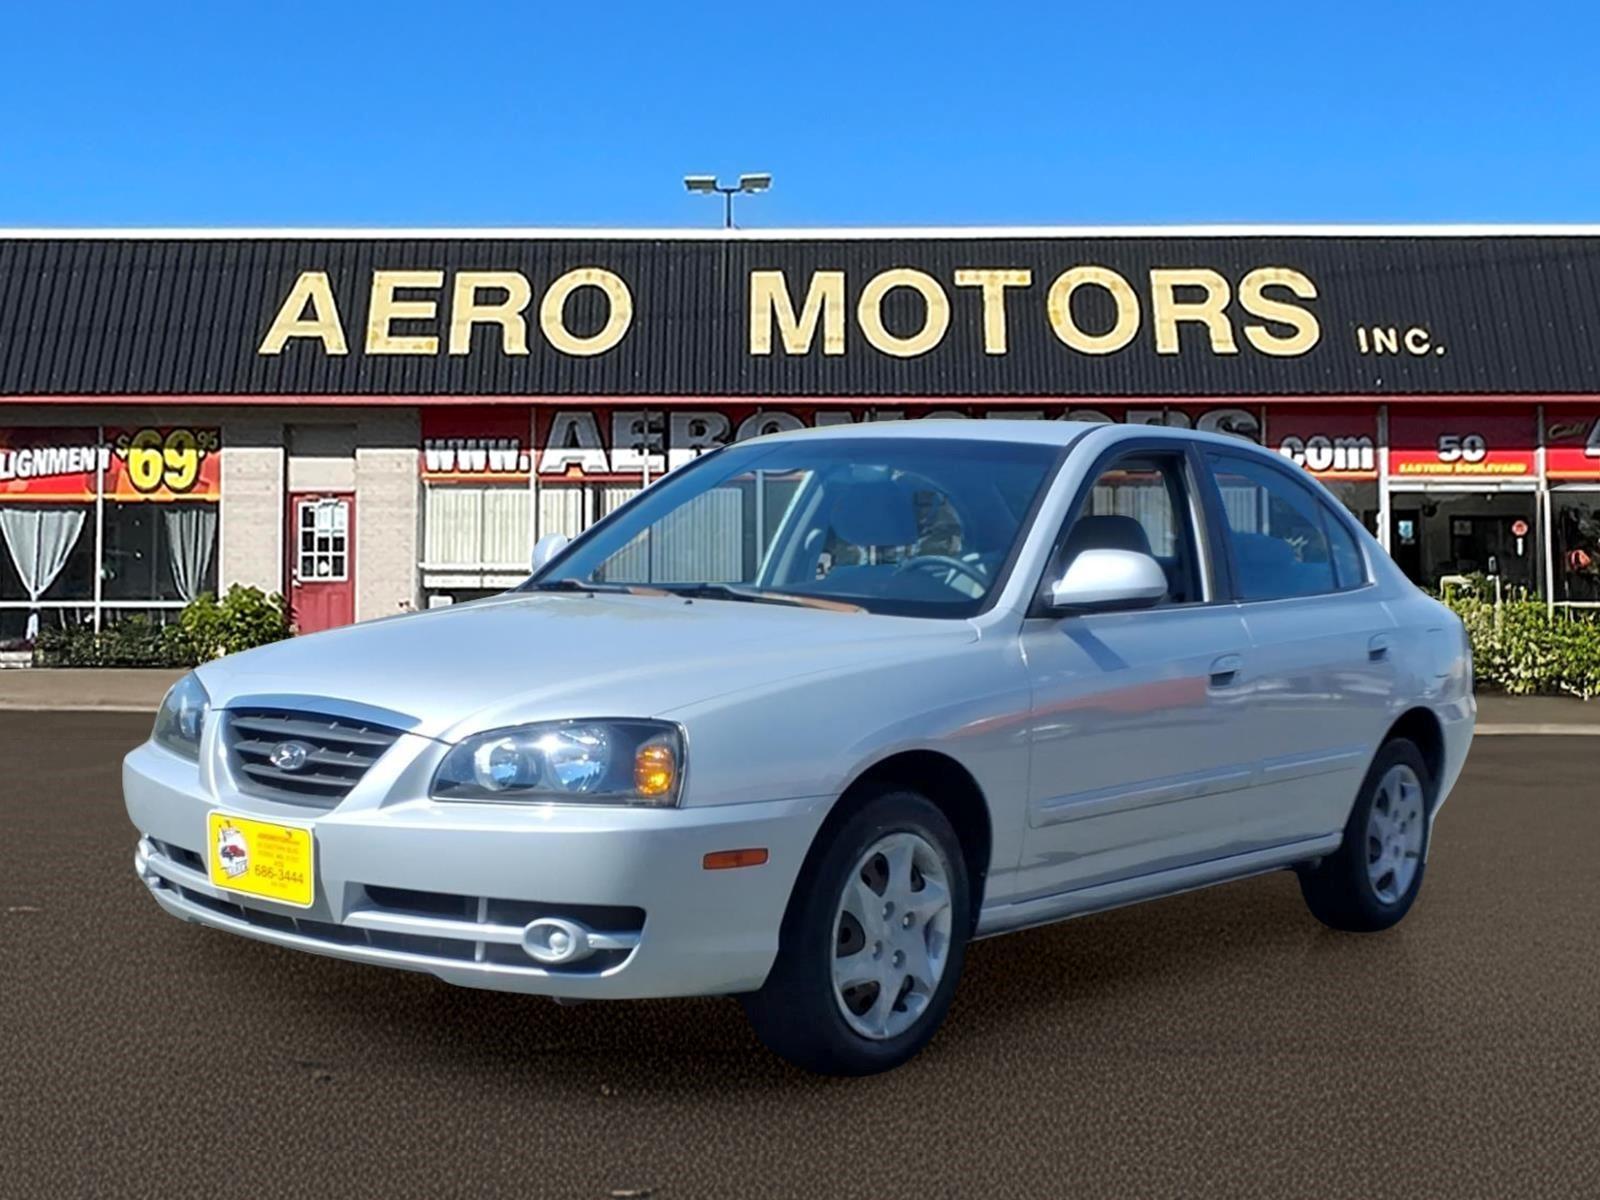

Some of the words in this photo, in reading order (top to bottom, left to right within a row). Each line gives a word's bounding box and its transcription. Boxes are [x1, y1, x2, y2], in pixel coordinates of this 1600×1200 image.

[258, 268, 633, 356] AERO
[750, 266, 1321, 356] MOTORS
[1357, 327, 1445, 355] INC.
[424, 439, 529, 471] www.
[1438, 435, 1486, 461] 50
[1399, 463, 1453, 473] EASTERN
[1454, 462, 1527, 473] BOULEVARD
[255, 864, 304, 884] 686-3444
